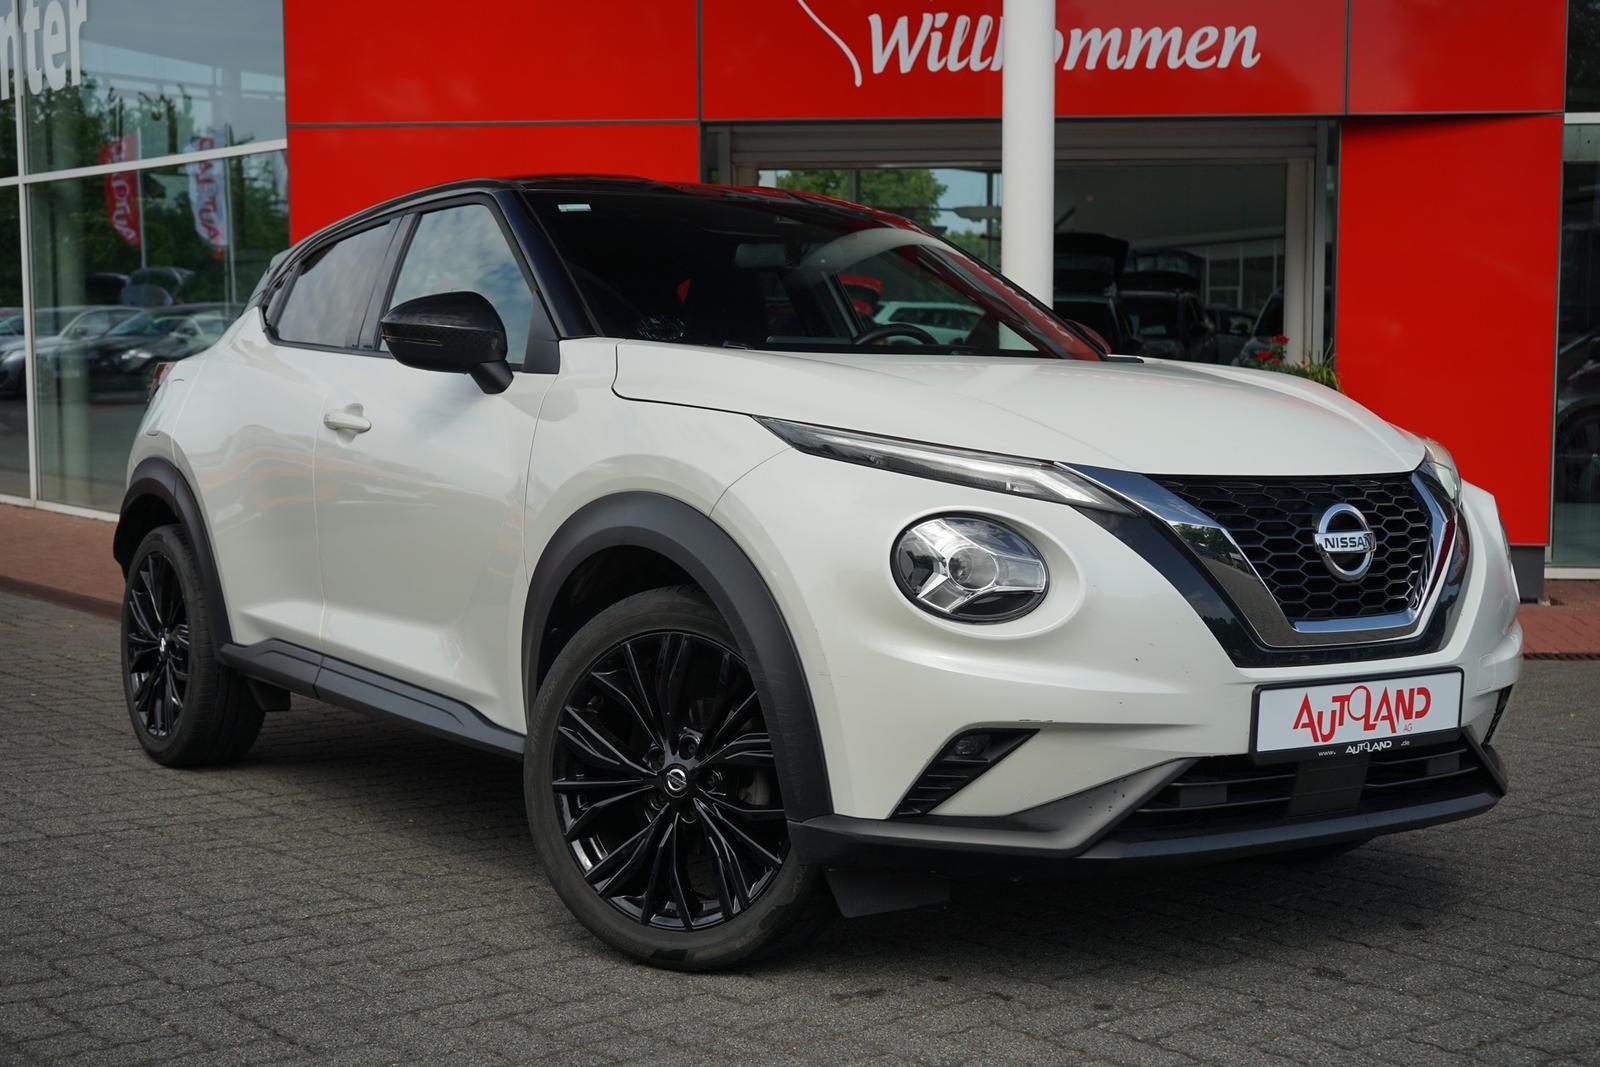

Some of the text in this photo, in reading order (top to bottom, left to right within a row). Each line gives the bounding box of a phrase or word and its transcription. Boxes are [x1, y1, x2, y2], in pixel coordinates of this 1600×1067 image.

[868, 12, 1261, 74] Willmmen
[1293, 685, 1431, 742] AUTOLAND
[1345, 741, 1392, 754] AUTOLAND
